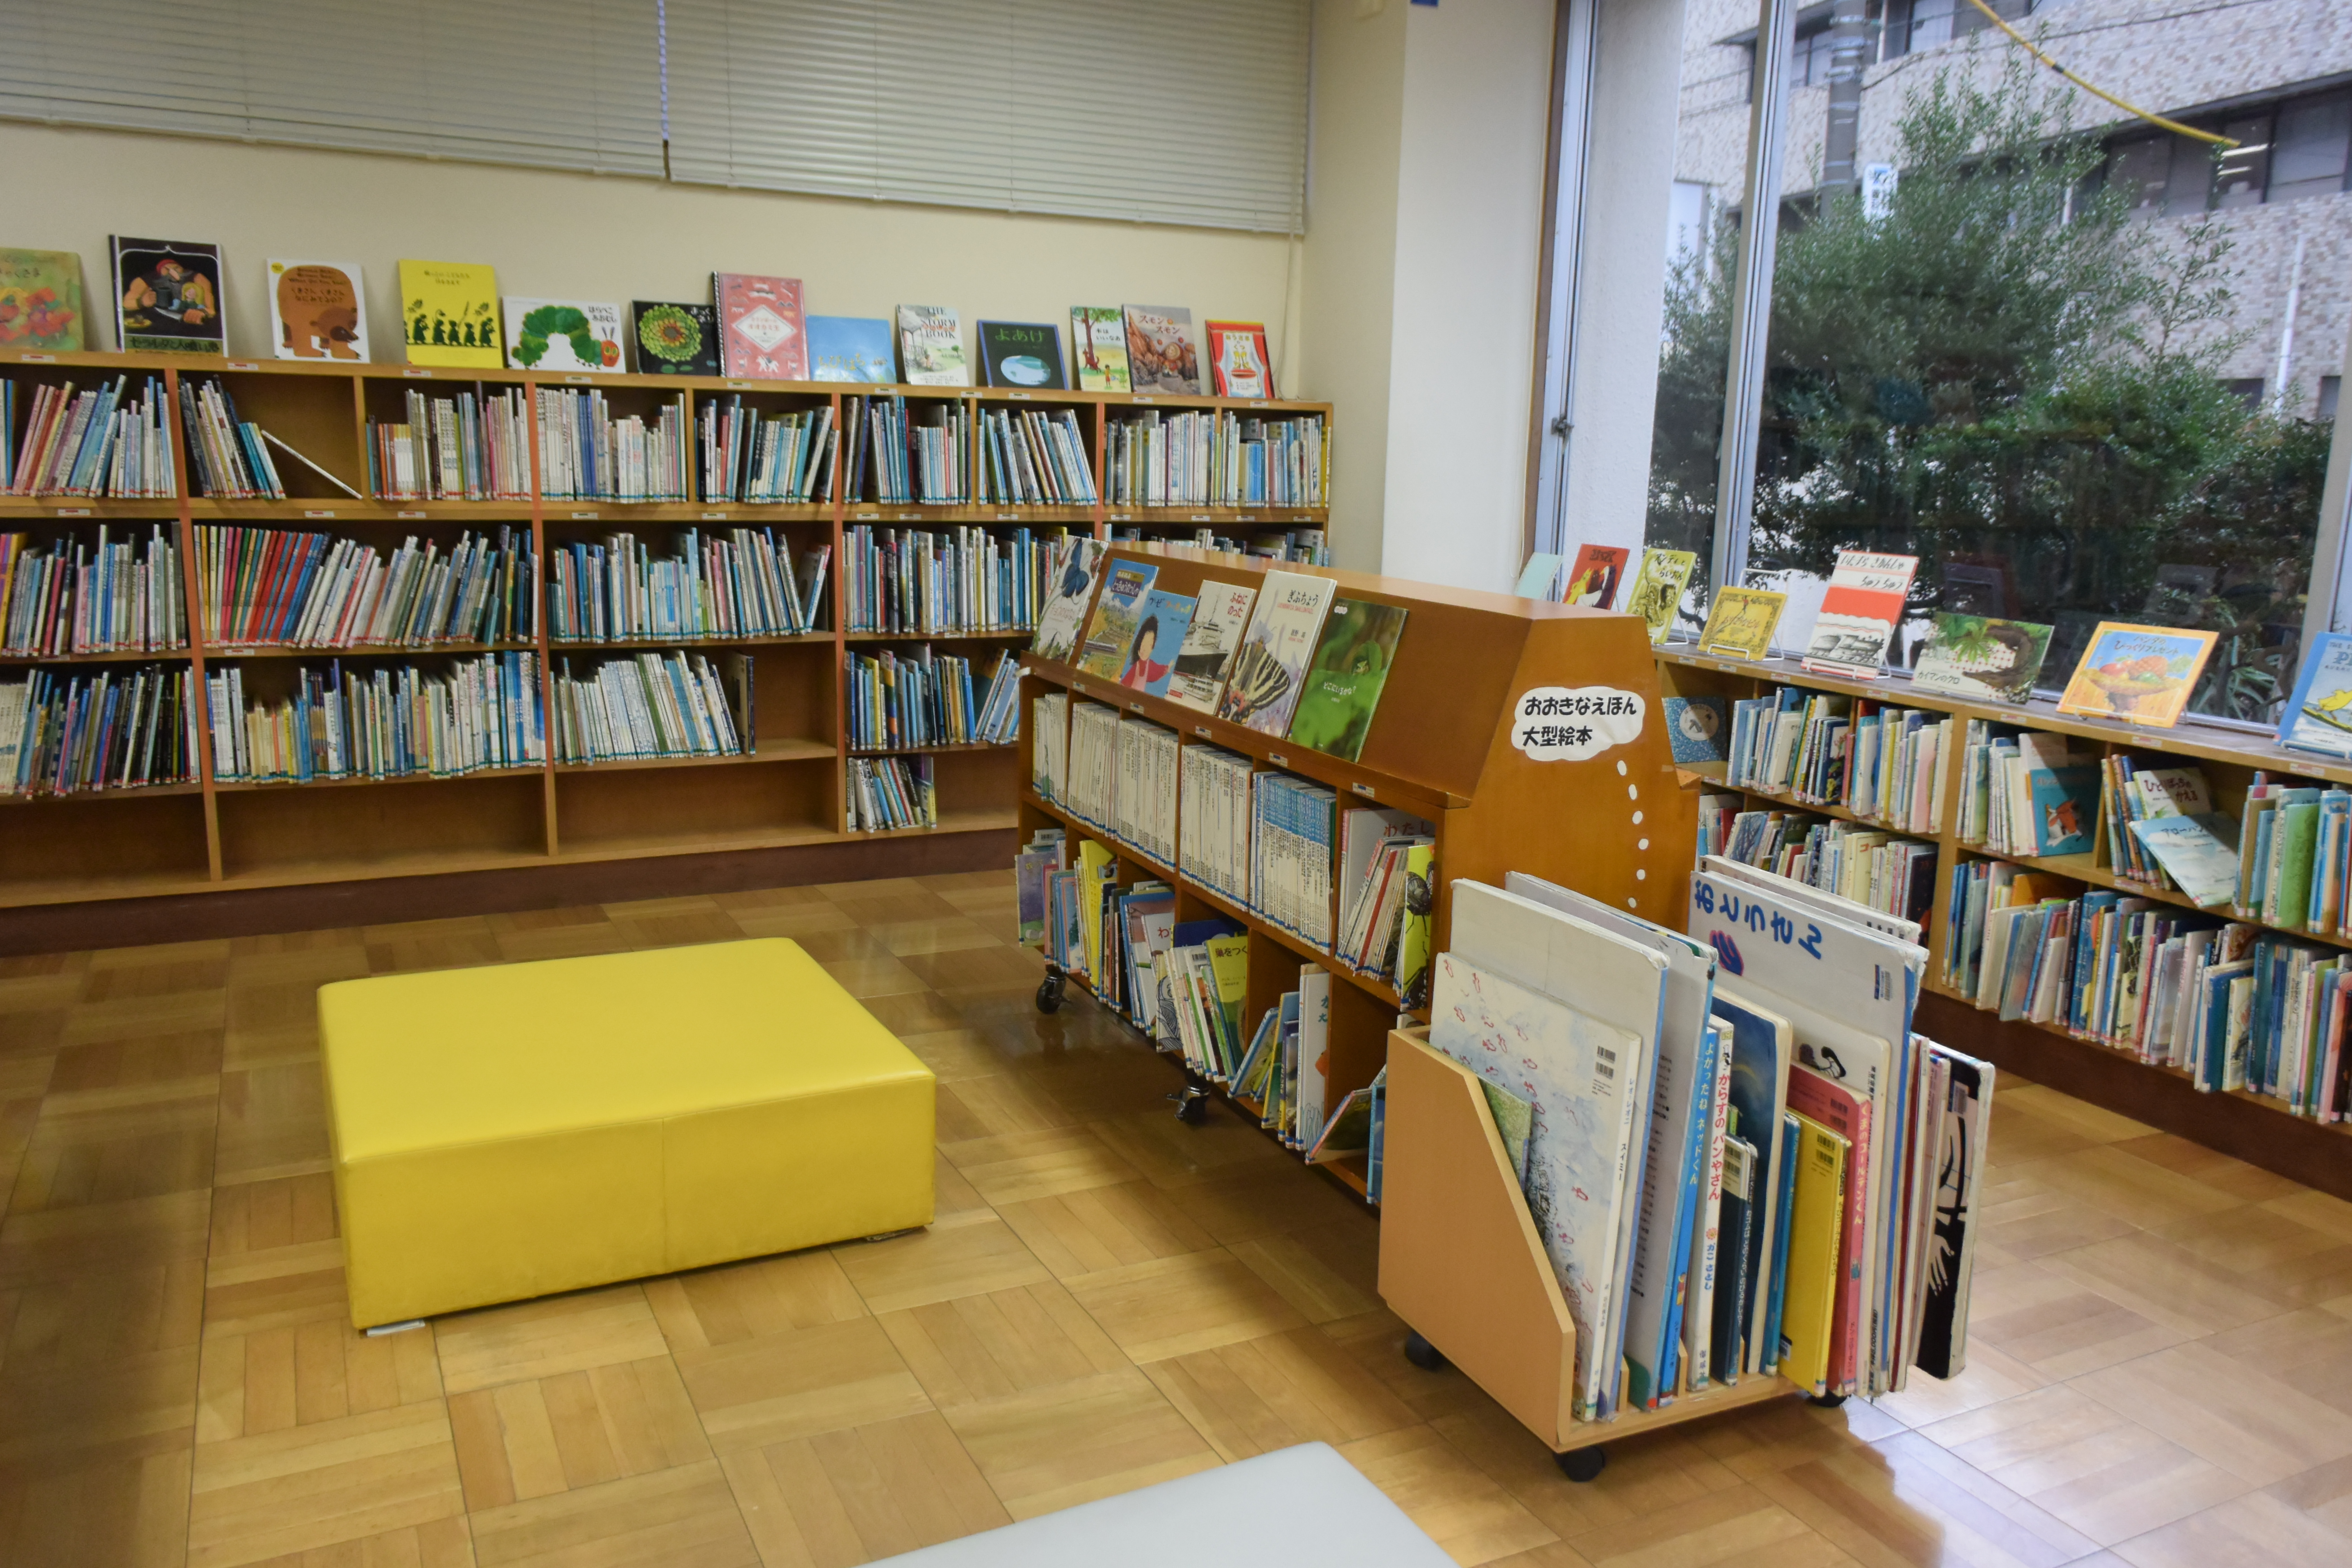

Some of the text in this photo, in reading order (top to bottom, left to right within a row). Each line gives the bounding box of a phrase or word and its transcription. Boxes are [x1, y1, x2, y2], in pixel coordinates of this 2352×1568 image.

[588, 306, 612, 314] はらぺこ
[927, 307, 945, 315] THE
[592, 314, 618, 323] あおむし
[1140, 315, 1163, 324] スモン
[926, 330, 955, 339] BOOK
[995, 328, 1045, 343] よあけ
[1156, 325, 1180, 334] スモン
[818, 353, 866, 371] ちびはち
[1229, 592, 1247, 605] ふねに
[1287, 589, 1319, 607] ぎふちょう
[1226, 605, 1242, 619] のった
[1916, 670, 1960, 684] カイマンのクロ
[1323, 681, 1357, 695] どこにいるかな?
[1523, 697, 1637, 717] おおきなえほん
[1522, 726, 1592, 747] 大型絵本
[1384, 819, 1432, 837] わたし
[1694, 879, 1822, 960] おとうさん
[1689, 1042, 1714, 1185] よかったね ネッドくん
[1708, 1073, 1731, 1201] からすのパンやさん
[1854, 1105, 1868, 1225] くまのコールテンくん
